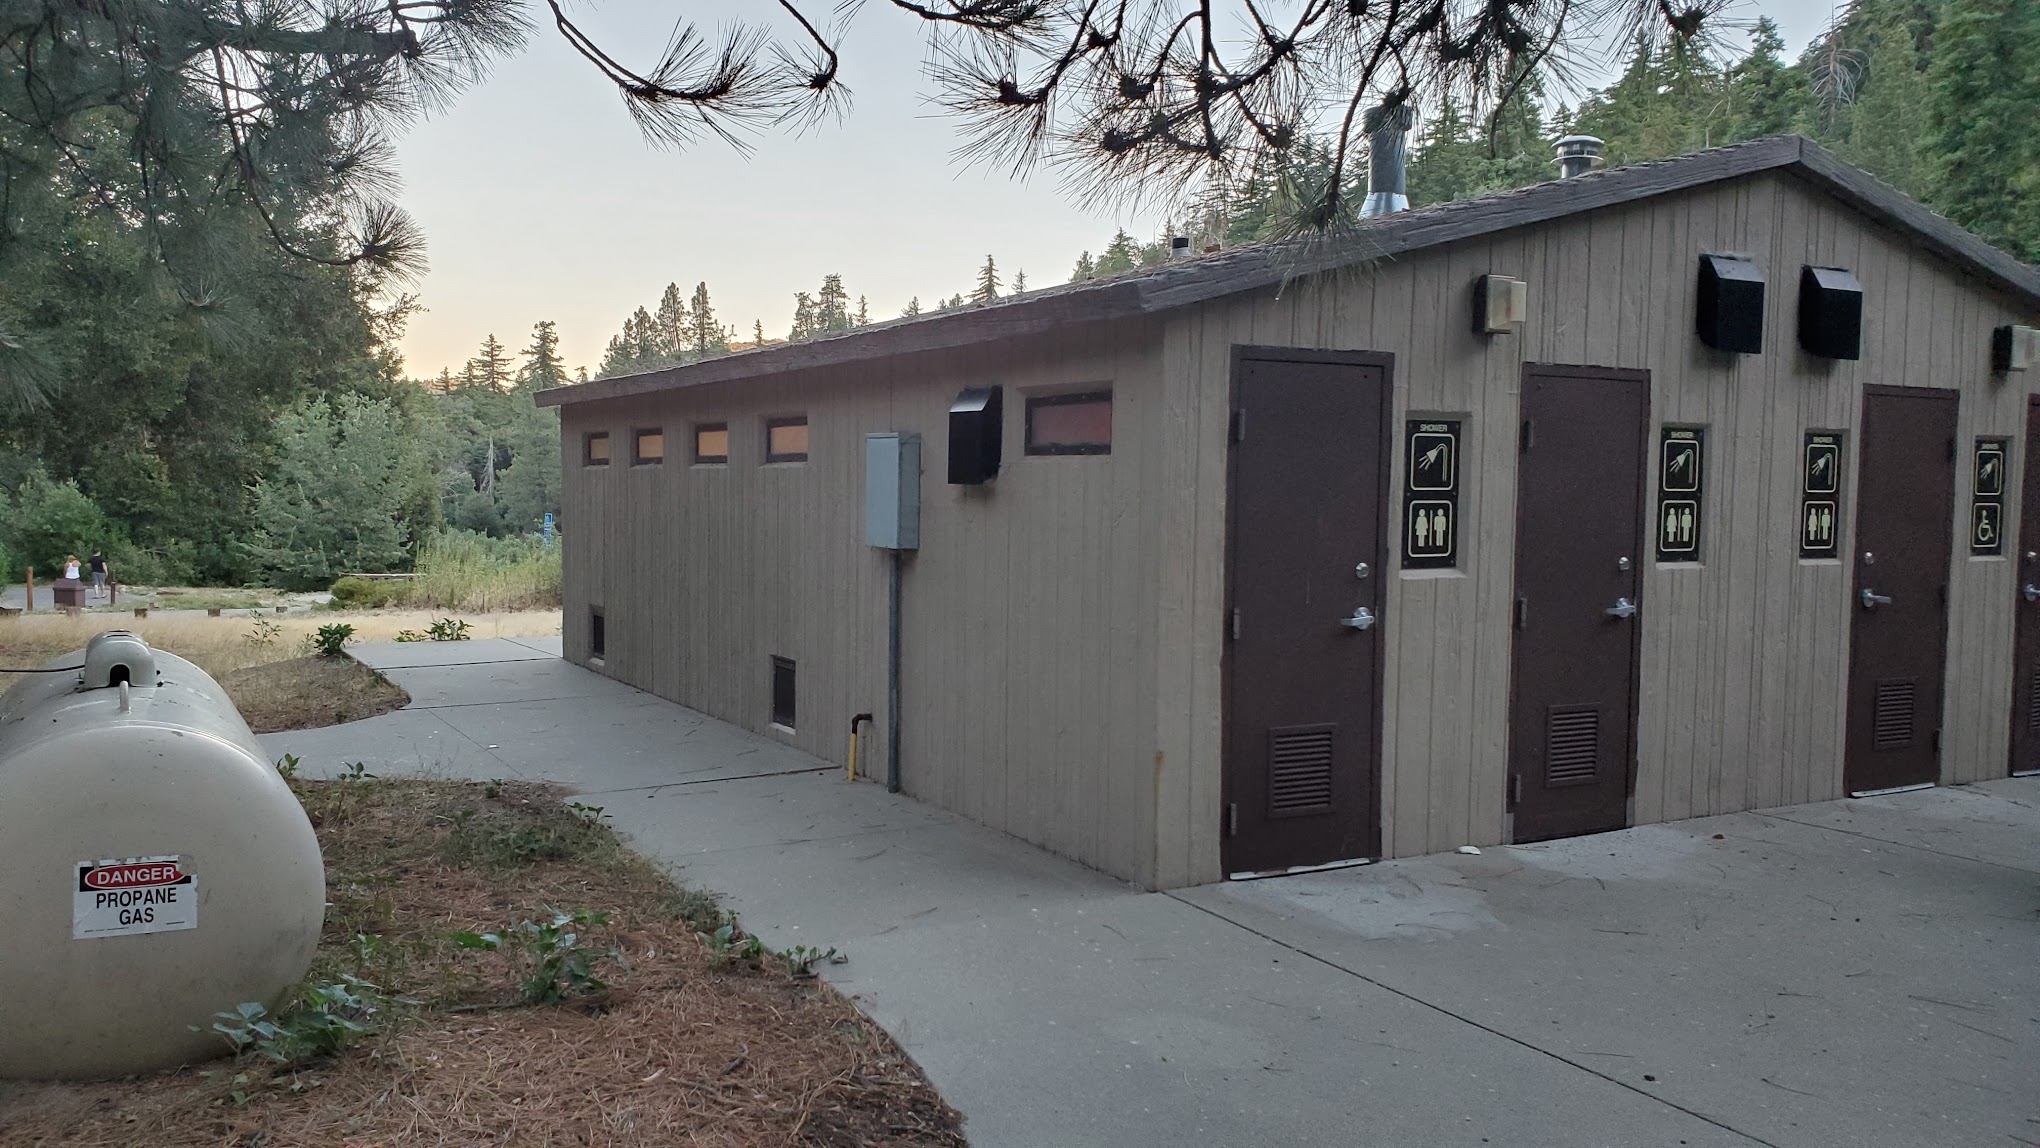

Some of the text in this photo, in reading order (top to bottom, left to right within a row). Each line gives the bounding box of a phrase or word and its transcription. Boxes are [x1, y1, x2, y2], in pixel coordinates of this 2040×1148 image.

[1420, 424, 1448, 432] SHOWER
[97, 867, 175, 885] DANGER
[96, 887, 177, 909] PROPANE
[119, 907, 154, 925] GAS
